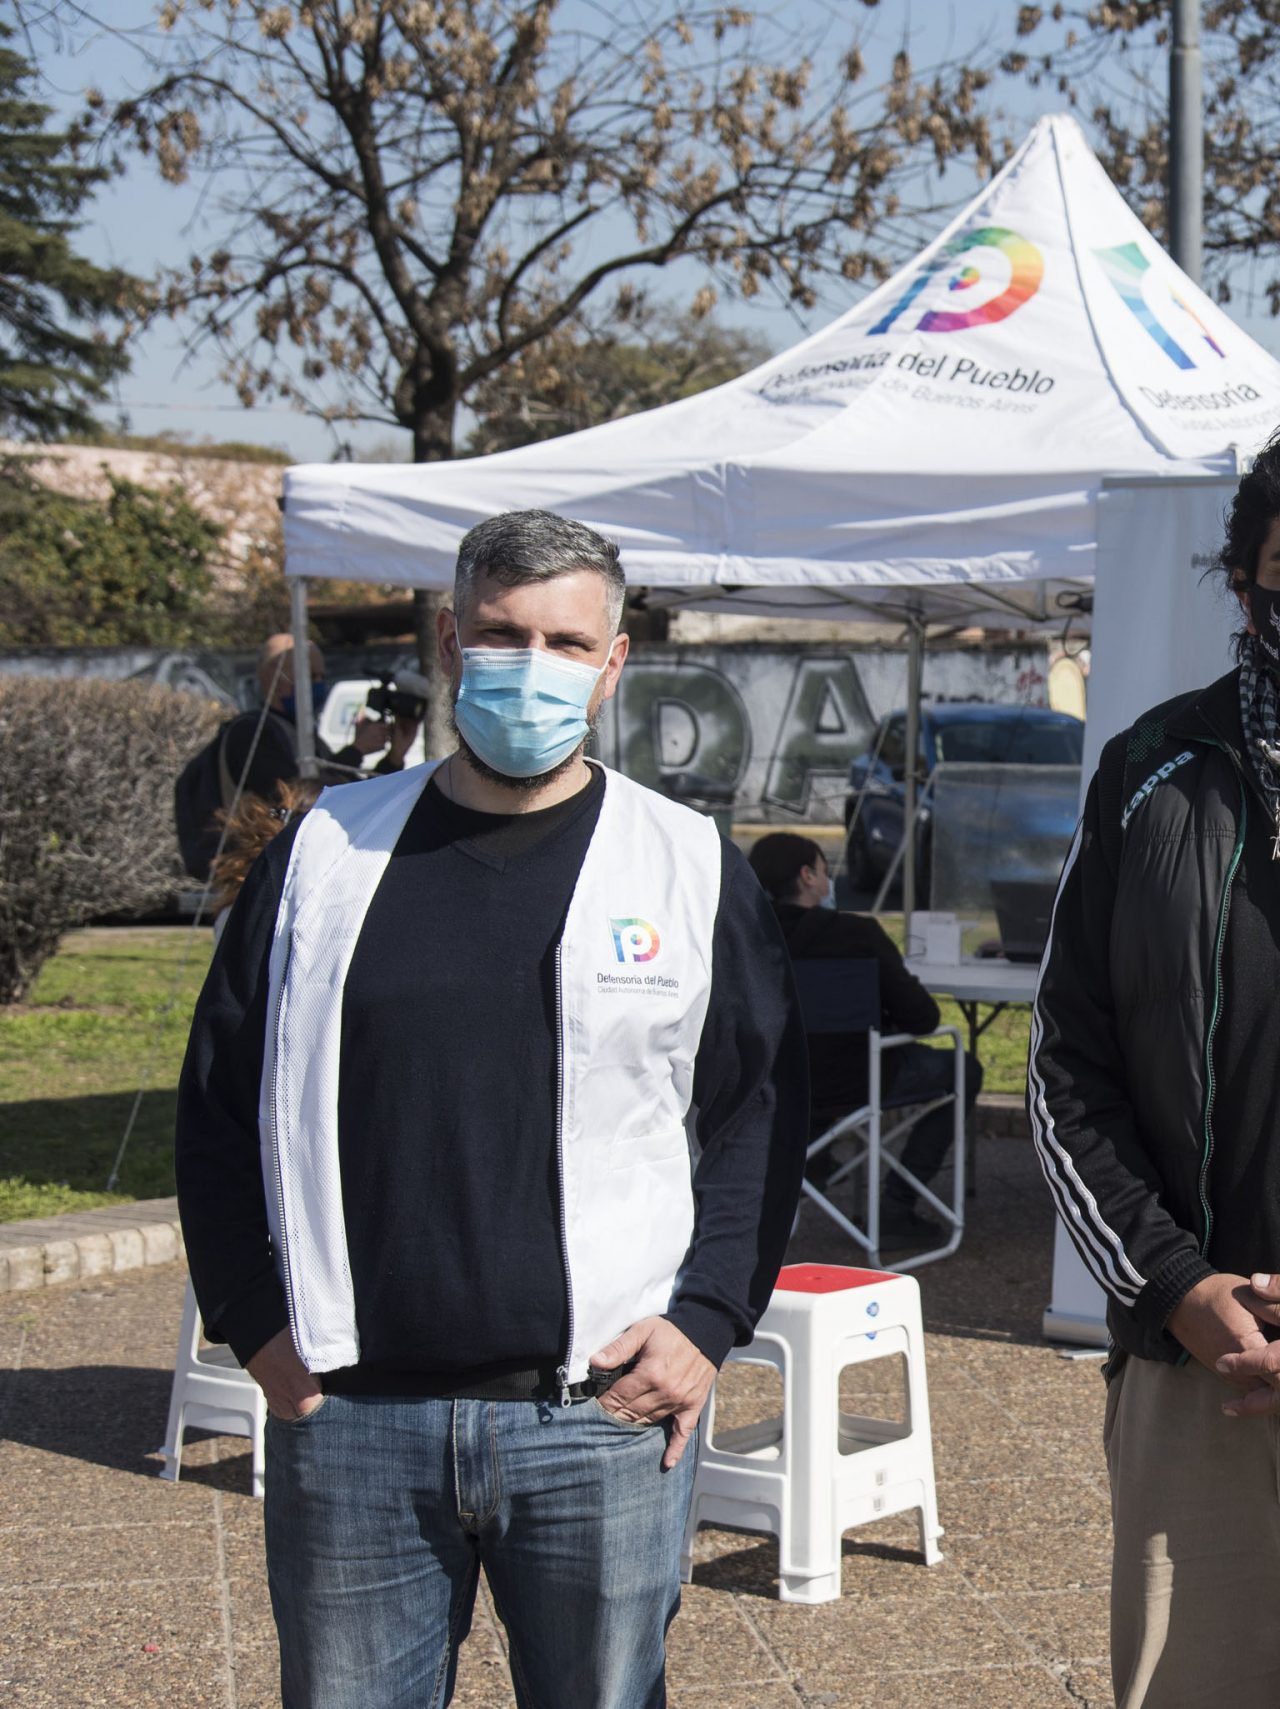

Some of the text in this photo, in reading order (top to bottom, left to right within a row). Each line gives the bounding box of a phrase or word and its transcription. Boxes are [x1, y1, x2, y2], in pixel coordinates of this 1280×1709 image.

[897, 352, 948, 379] del
[949, 357, 1056, 395] Pueblo
[1121, 751, 1195, 830] Kappa
[644, 975, 656, 986] del
[657, 976, 680, 989] Pueblo
